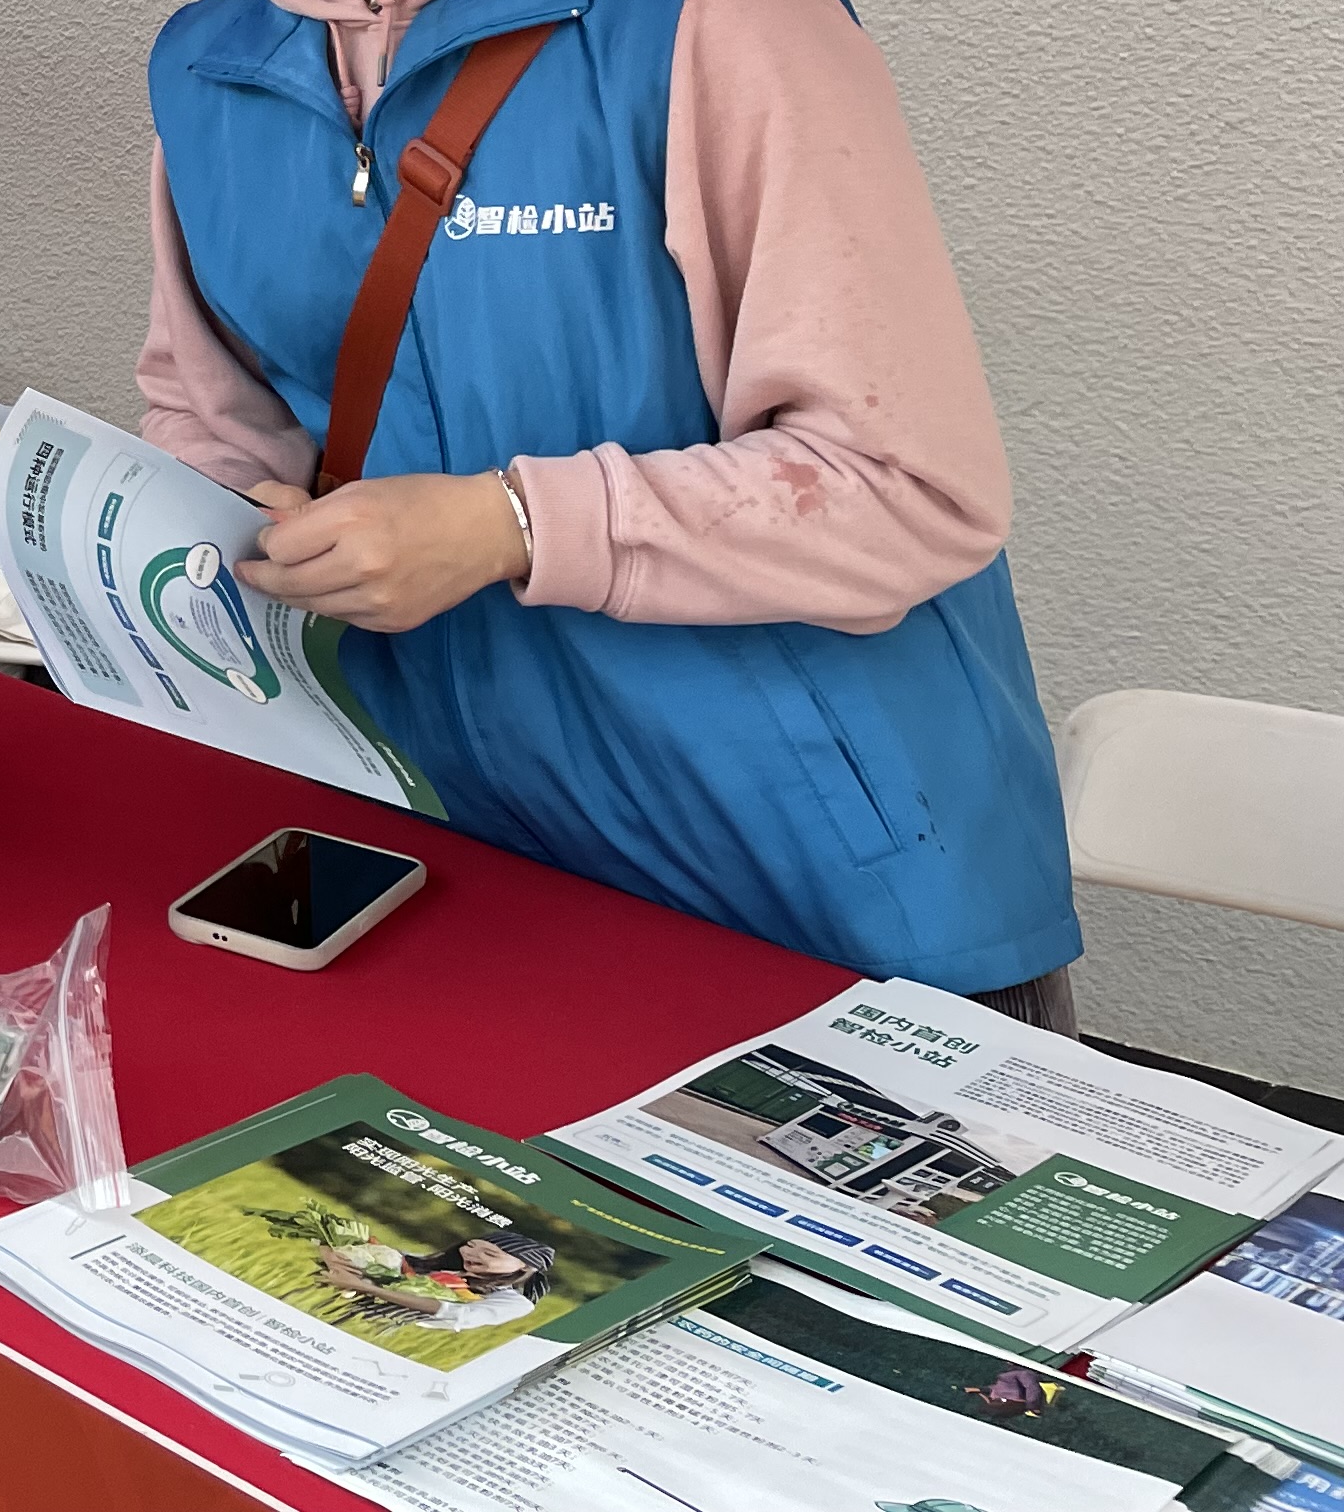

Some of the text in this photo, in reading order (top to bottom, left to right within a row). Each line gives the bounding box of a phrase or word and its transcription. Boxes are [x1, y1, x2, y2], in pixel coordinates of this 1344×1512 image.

[475, 202, 615, 235] 智检小站
[828, 1017, 957, 1068] 智检小站
[848, 1004, 980, 1054] 国内首创
[418, 1128, 541, 1186] 智检小站
